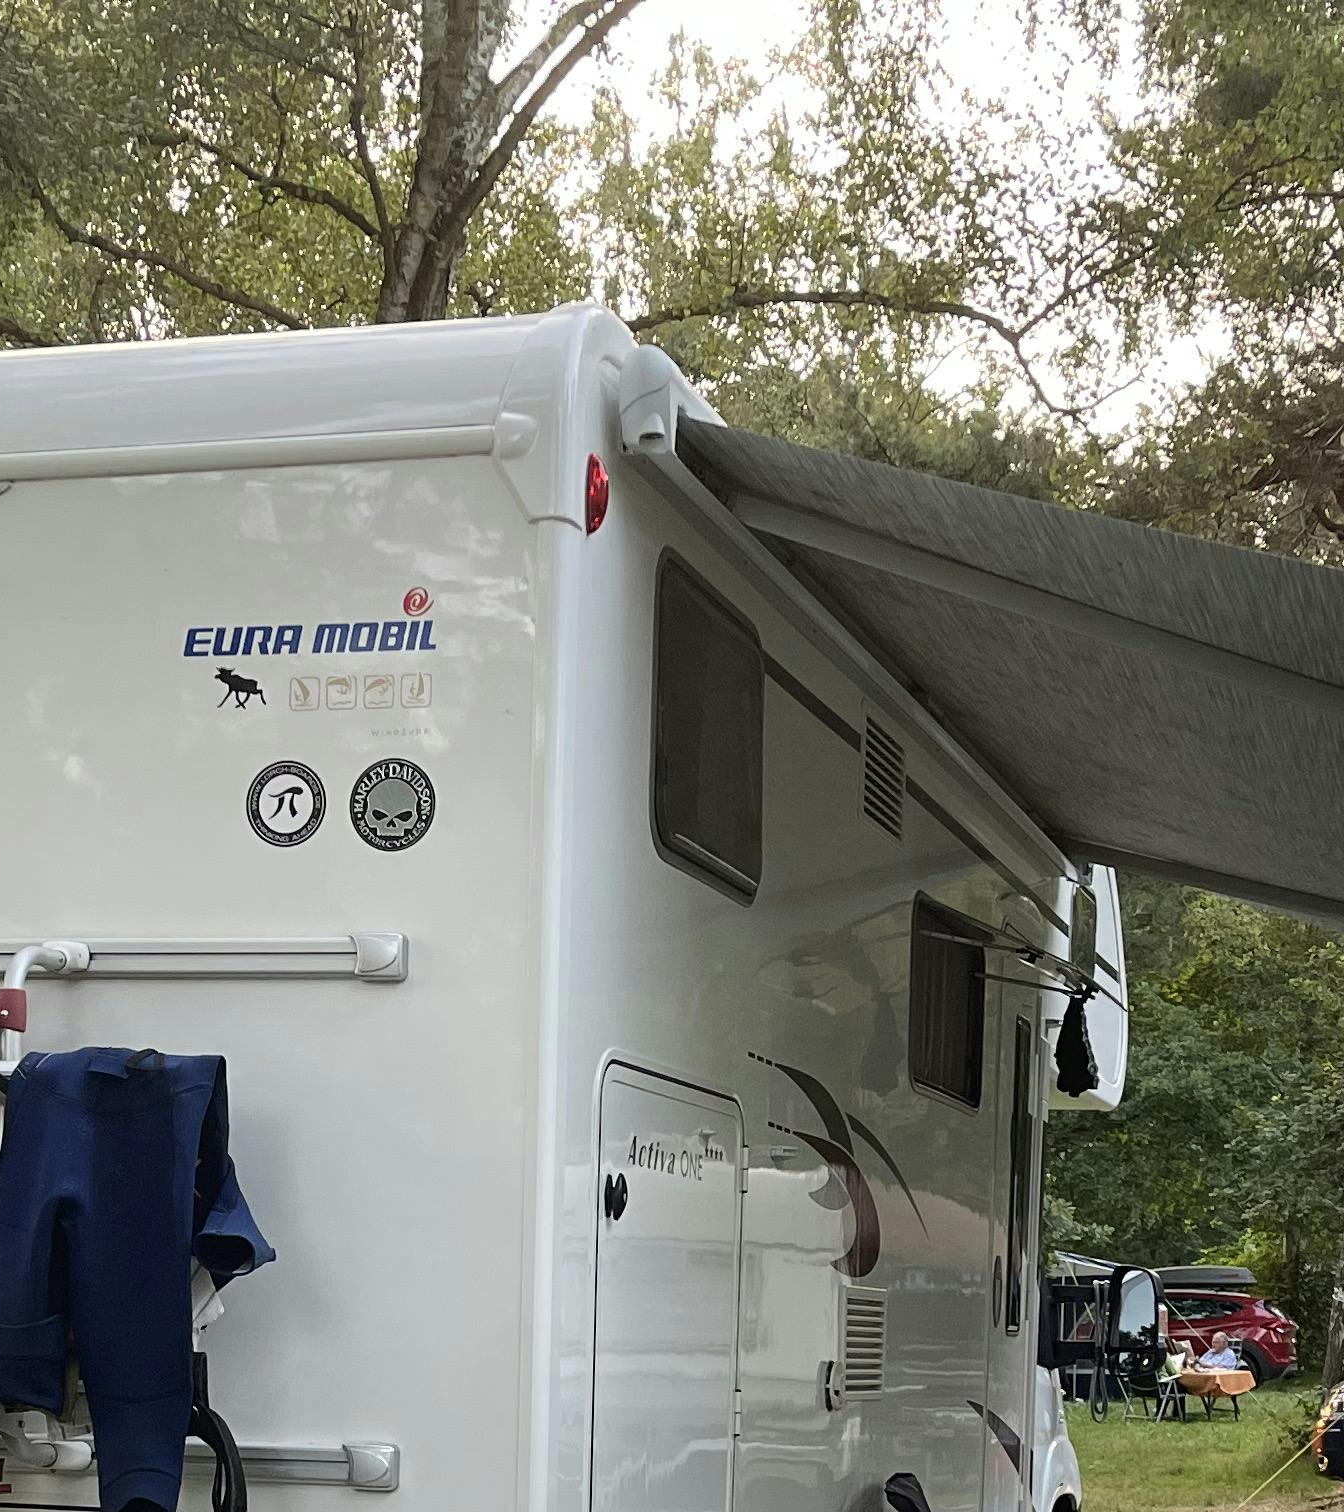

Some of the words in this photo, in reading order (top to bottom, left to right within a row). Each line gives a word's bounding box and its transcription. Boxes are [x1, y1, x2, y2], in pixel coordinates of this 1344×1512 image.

[183, 624, 303, 657] EURA
[311, 620, 437, 654] MOBIL
[356, 820, 426, 848] MOTORCYCLES
[627, 1135, 676, 1175] Activa
[680, 1150, 703, 1182] ONE
